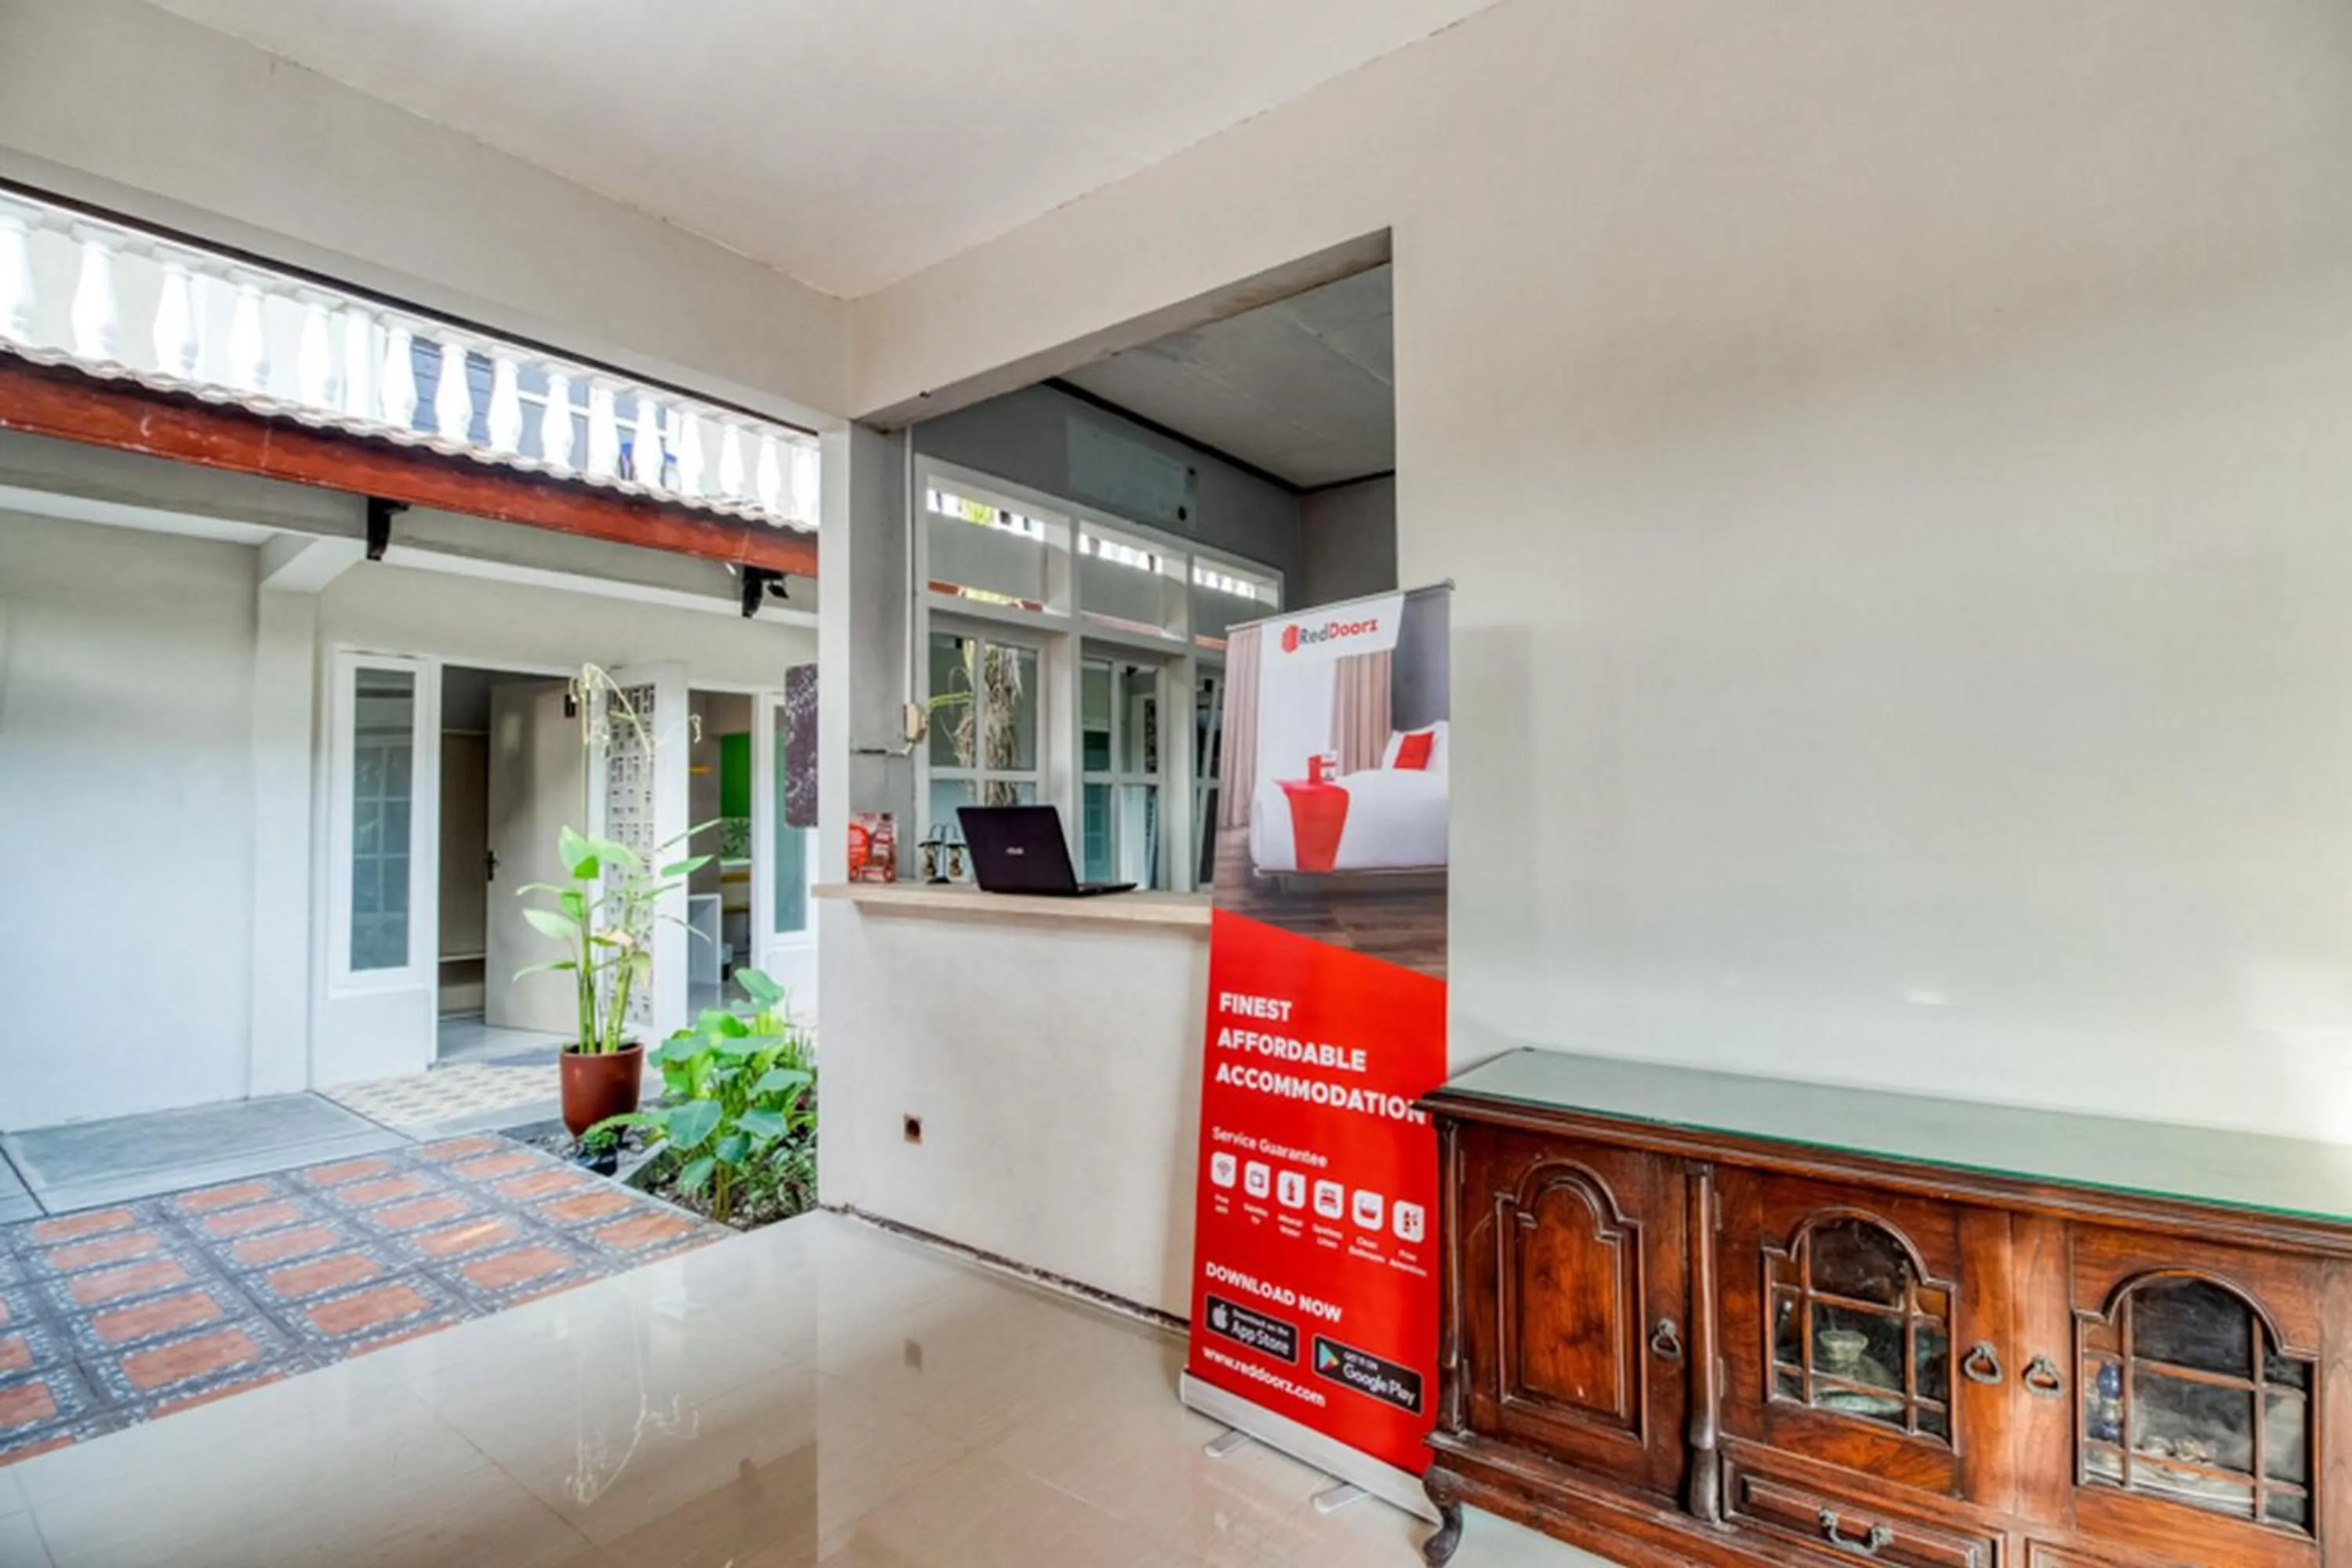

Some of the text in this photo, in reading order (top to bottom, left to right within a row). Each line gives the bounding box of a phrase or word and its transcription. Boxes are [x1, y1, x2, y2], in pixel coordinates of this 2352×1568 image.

[1299, 618, 1378, 644] RedDoorz
[1220, 993, 1292, 1022] FINEST
[1217, 1027, 1367, 1073] AFFORDABLE
[1211, 1126, 1327, 1168] Service Guarantee
[1205, 1261, 1342, 1323] DOWNLOAD NOW
[1231, 1320, 1290, 1356] App Store
[1203, 1346, 1326, 1407] www.reddoorz.com
[1343, 1363, 1416, 1406] Google Play
